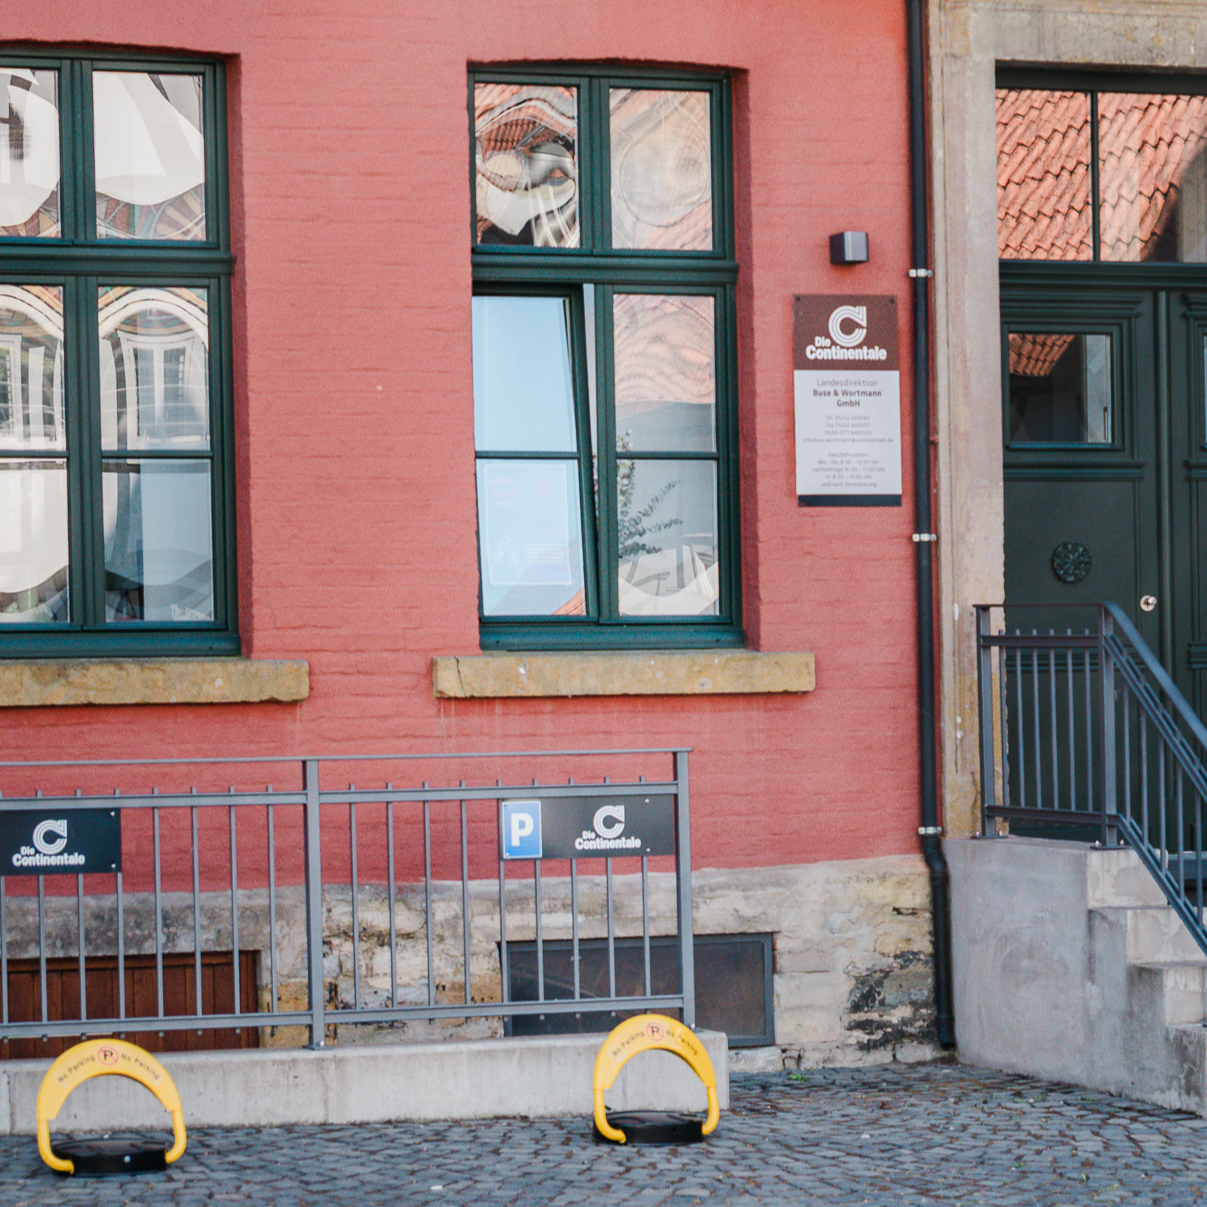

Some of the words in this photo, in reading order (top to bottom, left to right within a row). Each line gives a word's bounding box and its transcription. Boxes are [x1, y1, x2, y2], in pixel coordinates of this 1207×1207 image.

[814, 336, 831, 347] Die
[805, 345, 888, 360] Continentale
[816, 378, 878, 387] Landesdirektion
[813, 389, 831, 397] Buse
[833, 389, 839, 397] &
[841, 389, 882, 397] Wortmann
[836, 399, 860, 407] GmbH
[510, 812, 534, 847] P
[582, 830, 596, 839] Die
[574, 836, 642, 850] Continentale
[20, 845, 35, 855] Die
[12, 852, 86, 867] Continentale
